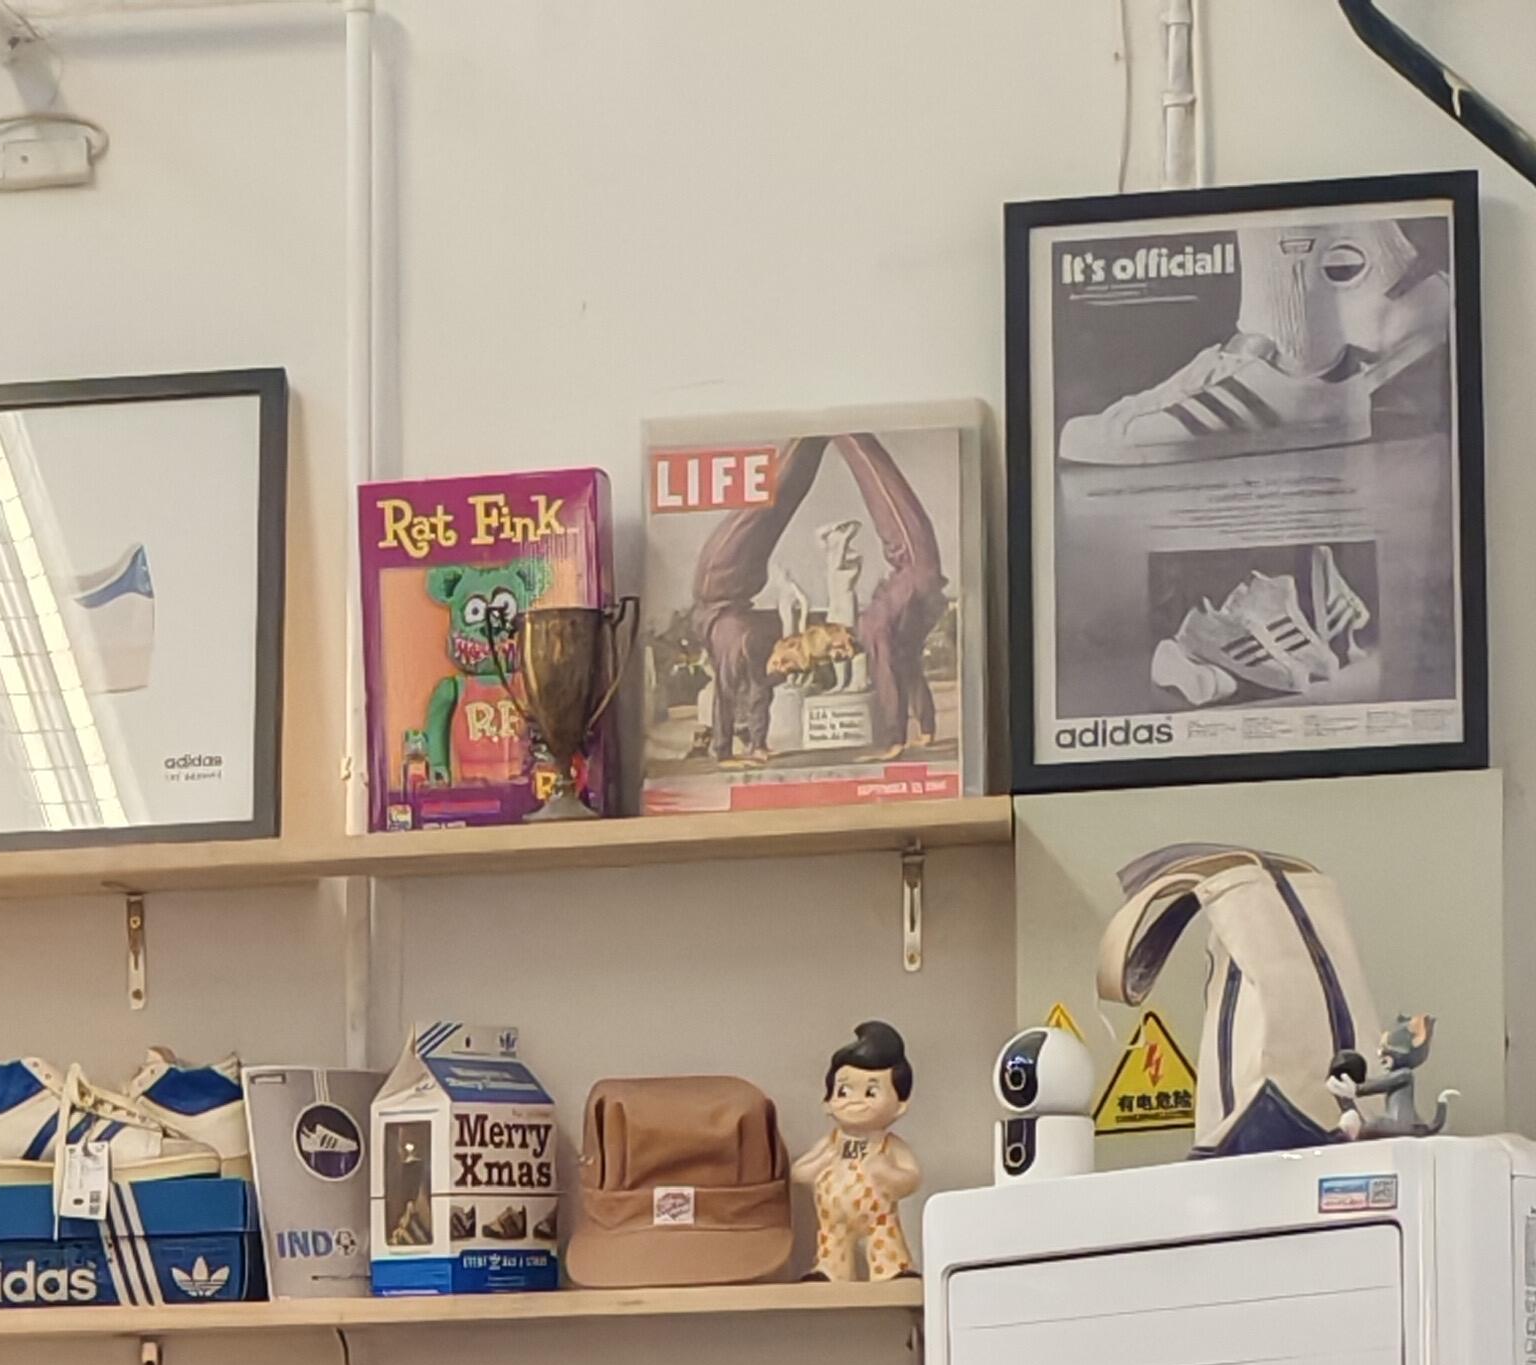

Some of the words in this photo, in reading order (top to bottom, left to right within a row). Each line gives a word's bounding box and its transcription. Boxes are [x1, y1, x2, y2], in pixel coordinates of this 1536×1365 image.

[1062, 252, 1106, 284] It's
[657, 454, 769, 507] LIFE
[376, 499, 458, 558] Rat
[467, 493, 565, 546] Fink
[1055, 719, 1174, 749] adidas
[454, 1113, 552, 1158] Merry
[454, 1154, 552, 1189] Xmas
